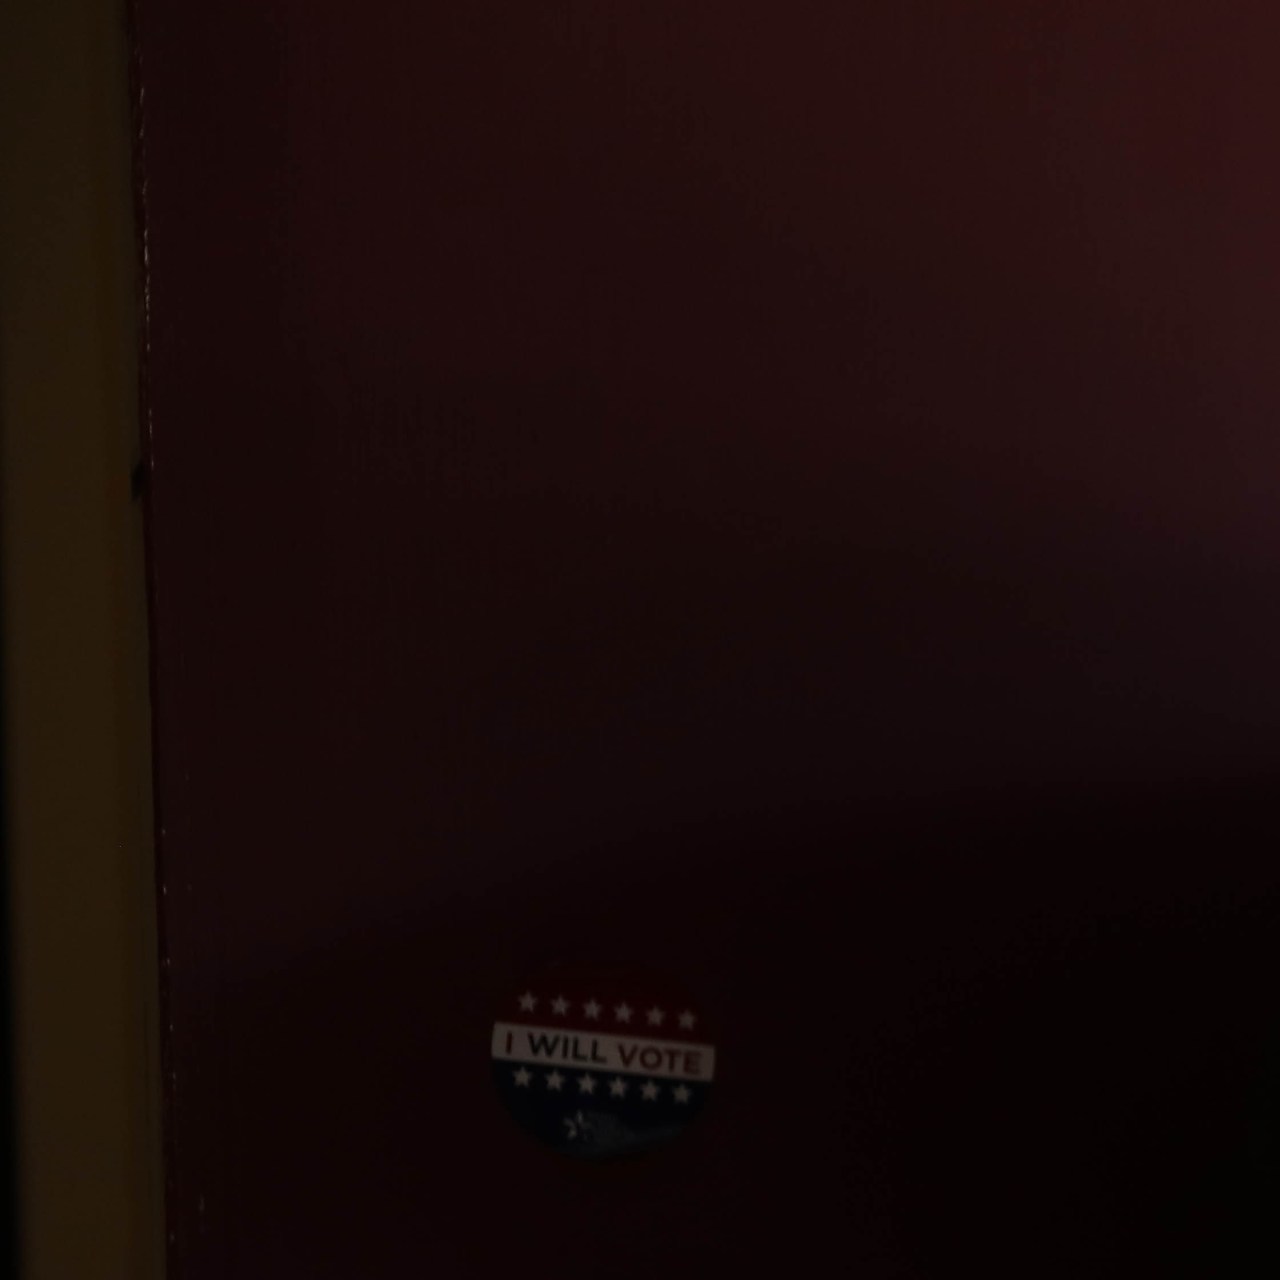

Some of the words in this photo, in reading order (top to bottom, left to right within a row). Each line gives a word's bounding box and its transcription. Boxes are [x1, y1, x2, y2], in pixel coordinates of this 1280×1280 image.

[505, 1032, 514, 1054] I
[528, 1034, 607, 1062] WILL
[618, 1044, 702, 1074] VOTE
